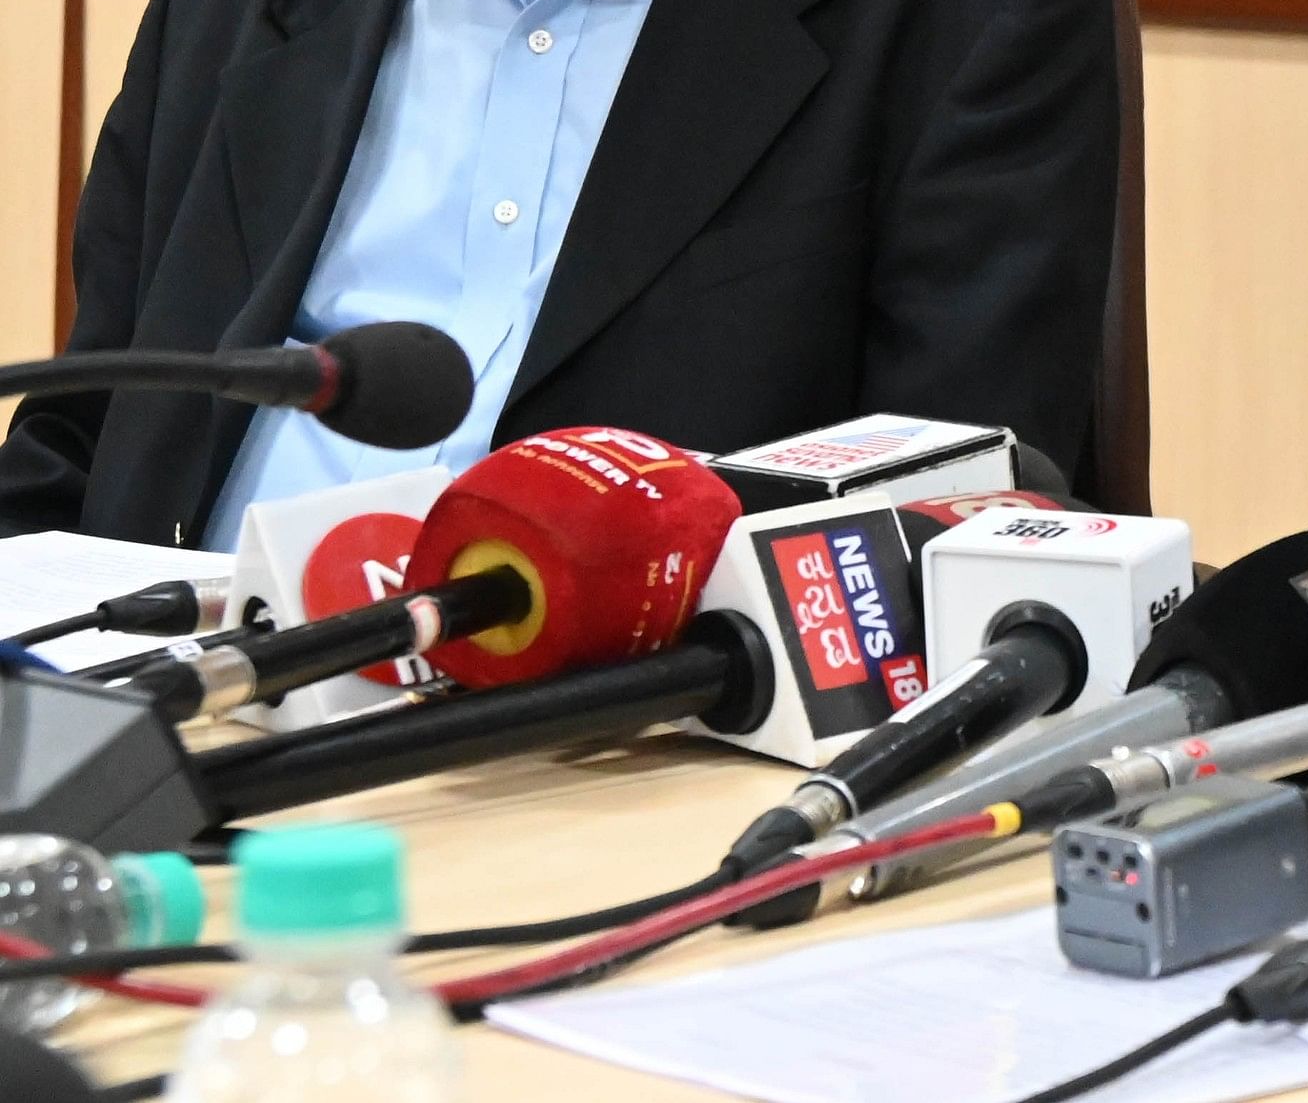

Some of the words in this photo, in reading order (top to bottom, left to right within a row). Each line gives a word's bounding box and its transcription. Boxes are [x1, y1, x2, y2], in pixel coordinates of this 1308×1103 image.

[523, 436, 630, 486] POWER
[635, 478, 663, 499] TV
[993, 524, 1070, 539] 360
[796, 550, 862, 669] ಕನ್ನಡ
[833, 534, 895, 659] NEWS
[889, 660, 923, 701] 18
